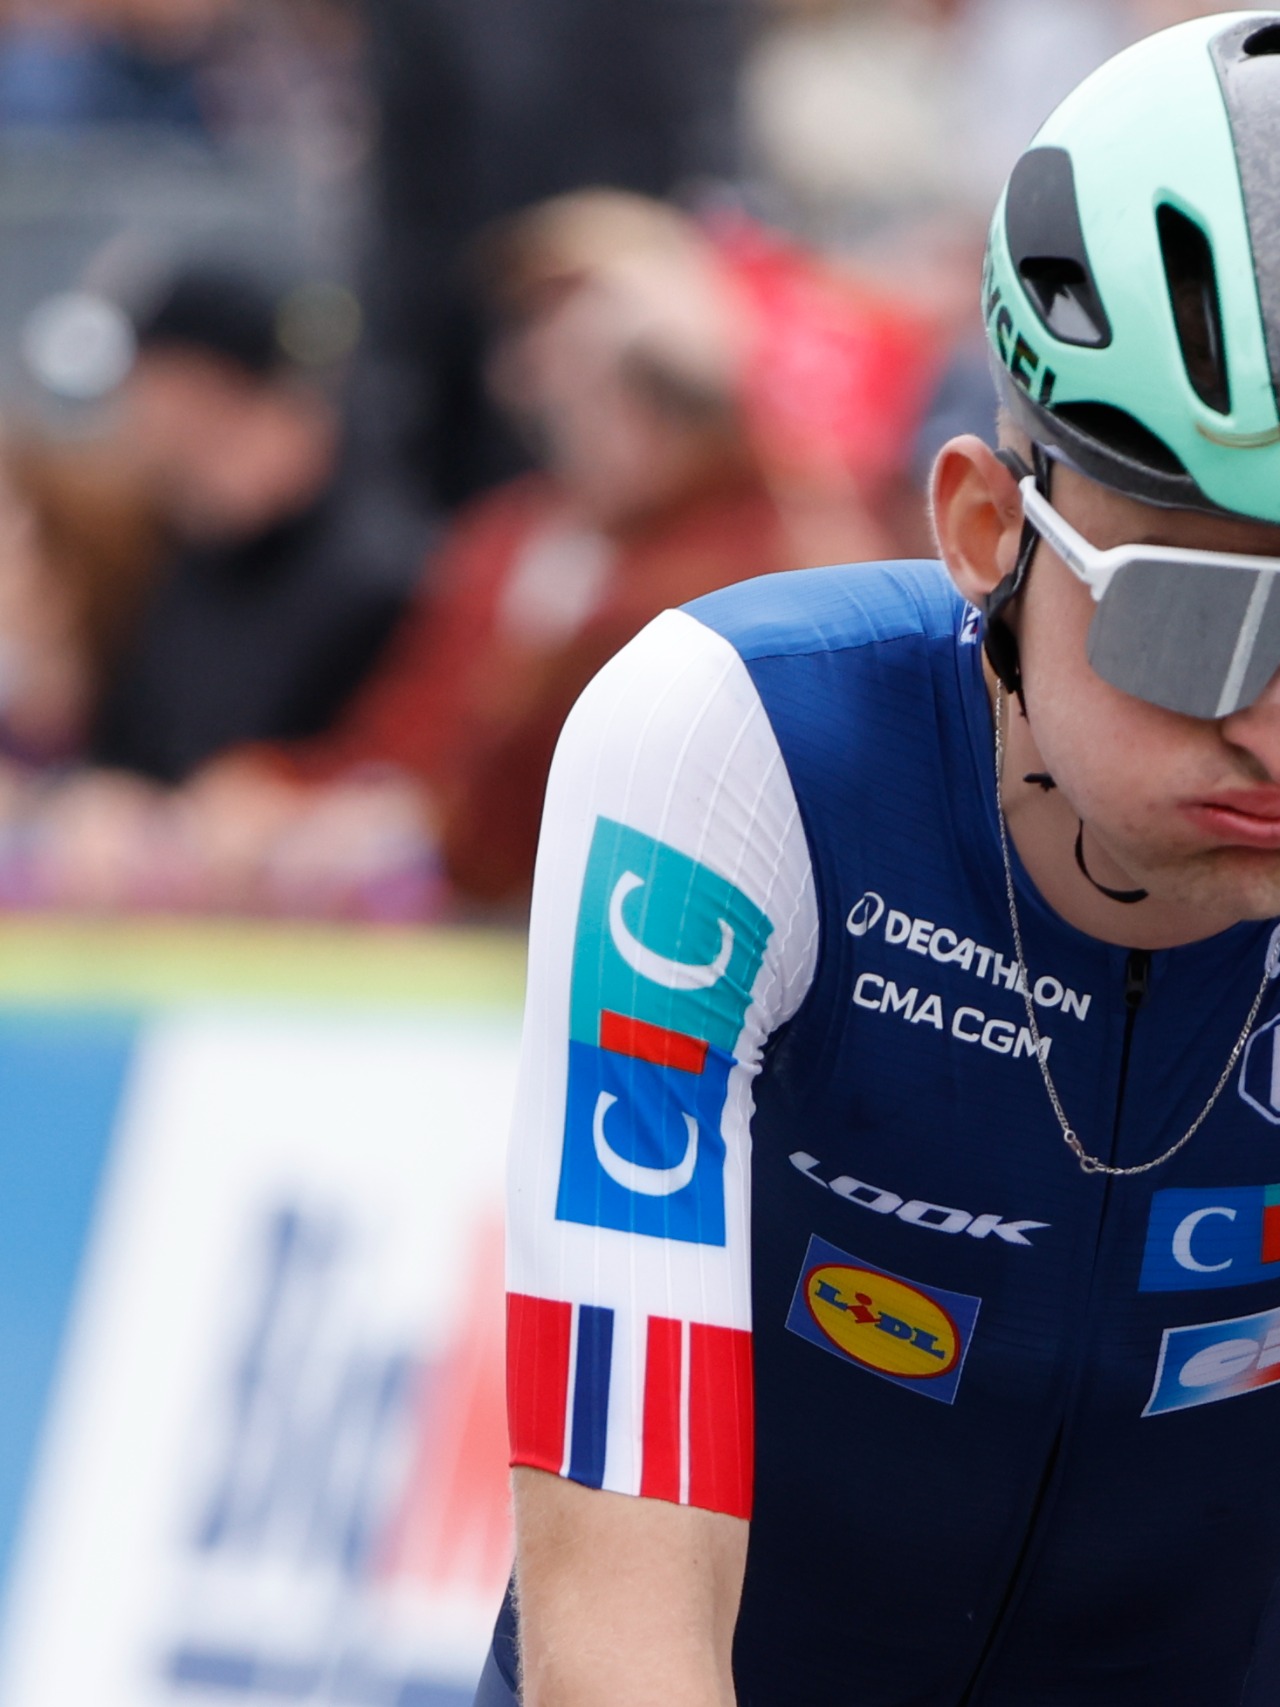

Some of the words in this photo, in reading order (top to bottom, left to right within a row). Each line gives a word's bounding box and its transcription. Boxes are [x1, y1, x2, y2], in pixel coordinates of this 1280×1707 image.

[885, 909, 1092, 1021] DECATHLON
[593, 870, 735, 1197] CIC
[852, 972, 943, 1030] CMA
[951, 1006, 1052, 1063] CGM
[788, 1150, 1052, 1246] LOOK
